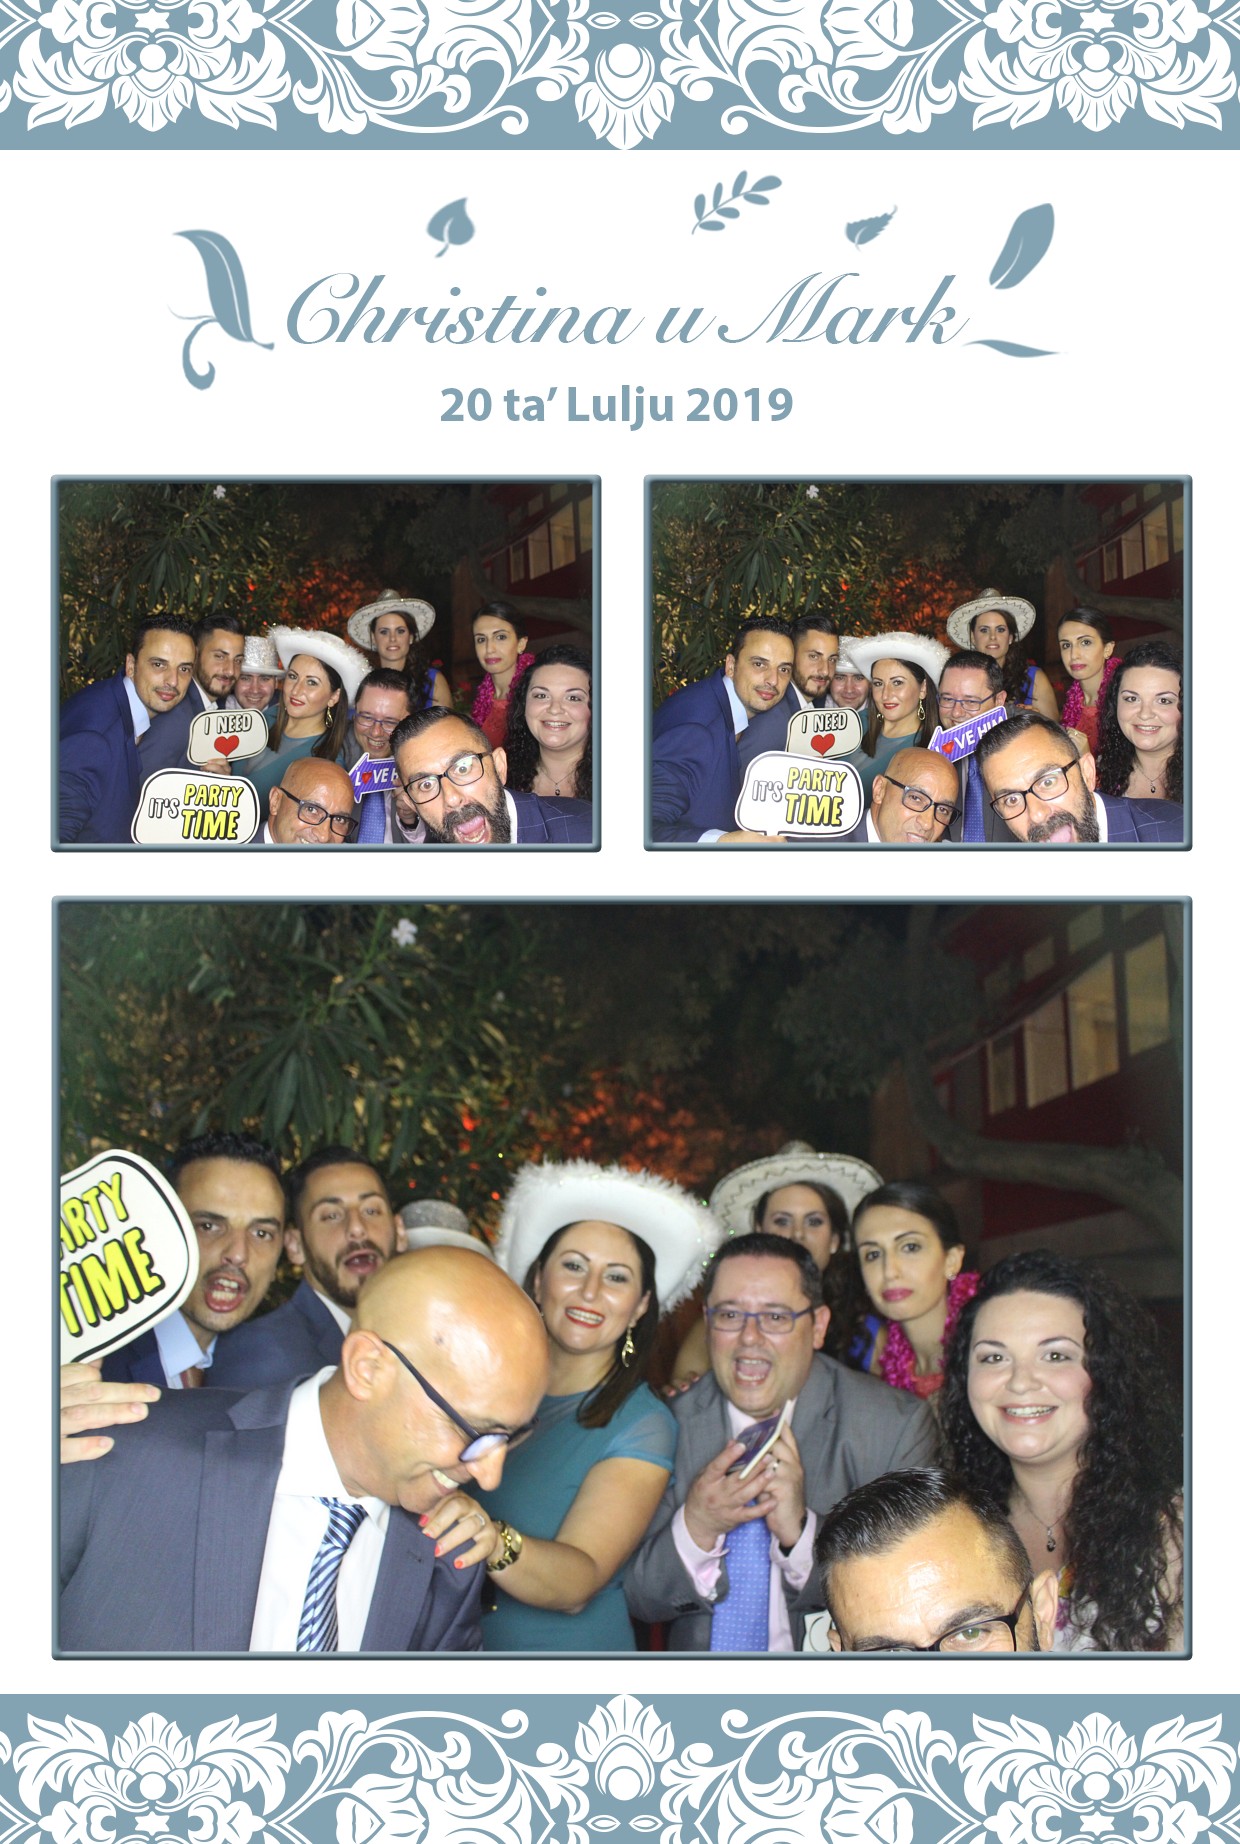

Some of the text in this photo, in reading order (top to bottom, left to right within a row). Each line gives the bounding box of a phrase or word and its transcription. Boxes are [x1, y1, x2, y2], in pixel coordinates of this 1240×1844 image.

[204, 714, 253, 735] I NEED
[801, 712, 848, 733] I NEED
[752, 780, 784, 802] IT'S
[787, 767, 847, 793] PARTY
[184, 784, 244, 807] PARTY
[148, 798, 179, 819] IT'S
[785, 794, 844, 827] TIME
[181, 809, 240, 840] TIME
[60, 1227, 166, 1338] TIME
